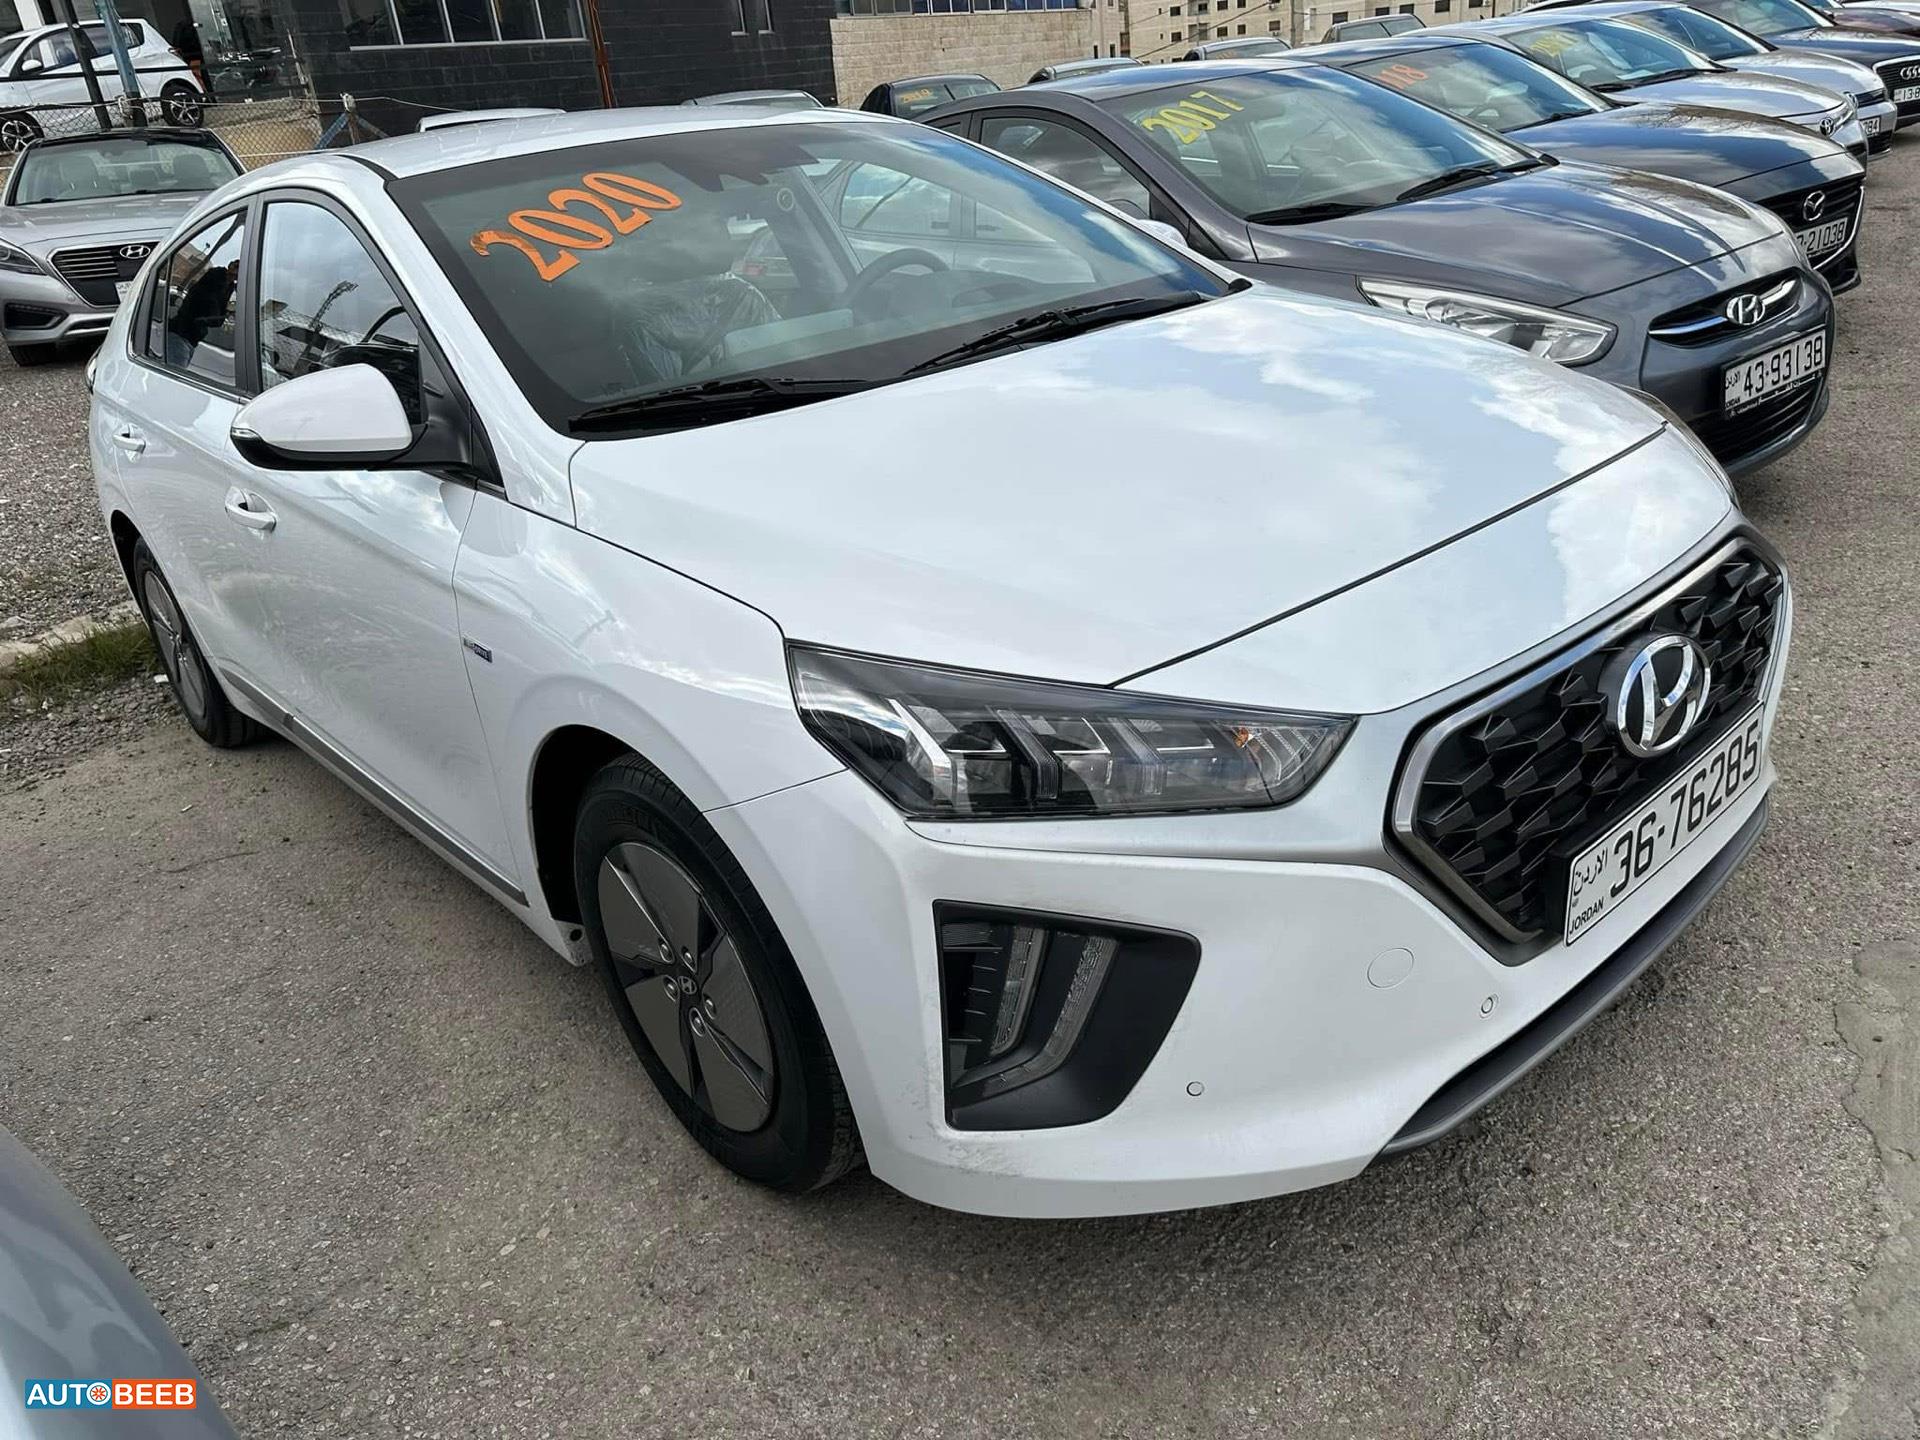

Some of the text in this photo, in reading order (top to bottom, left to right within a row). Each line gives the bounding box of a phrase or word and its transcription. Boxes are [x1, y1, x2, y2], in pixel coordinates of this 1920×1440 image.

[1142, 90, 1244, 144] 2017
[470, 171, 683, 282] 2020
[1743, 335, 1823, 396] 43-93138
[1609, 718, 1760, 898] 36-76285
[1568, 896, 1606, 935] JORDAN
